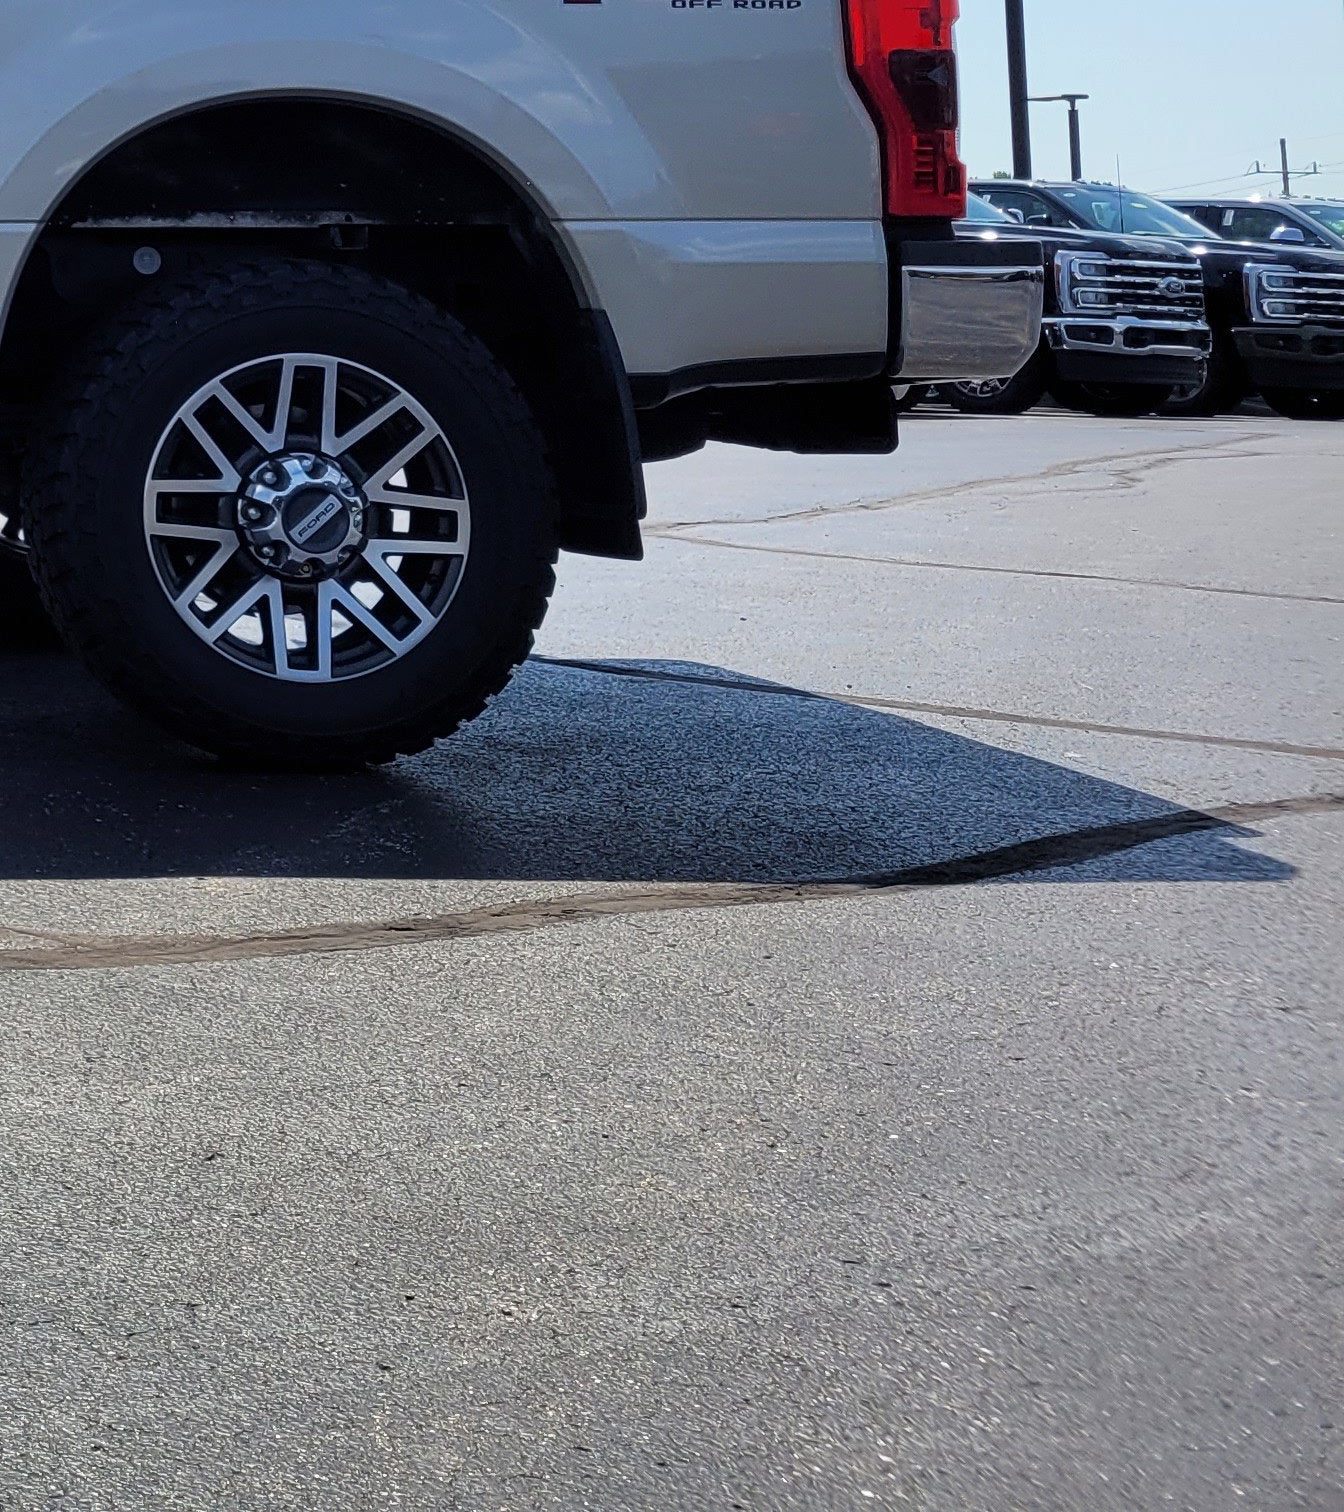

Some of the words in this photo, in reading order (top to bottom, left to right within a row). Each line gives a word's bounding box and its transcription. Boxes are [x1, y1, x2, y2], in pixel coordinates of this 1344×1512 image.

[671, 0, 722, 9] OFF
[733, 0, 802, 9] ROAD
[298, 502, 336, 538] FORD
